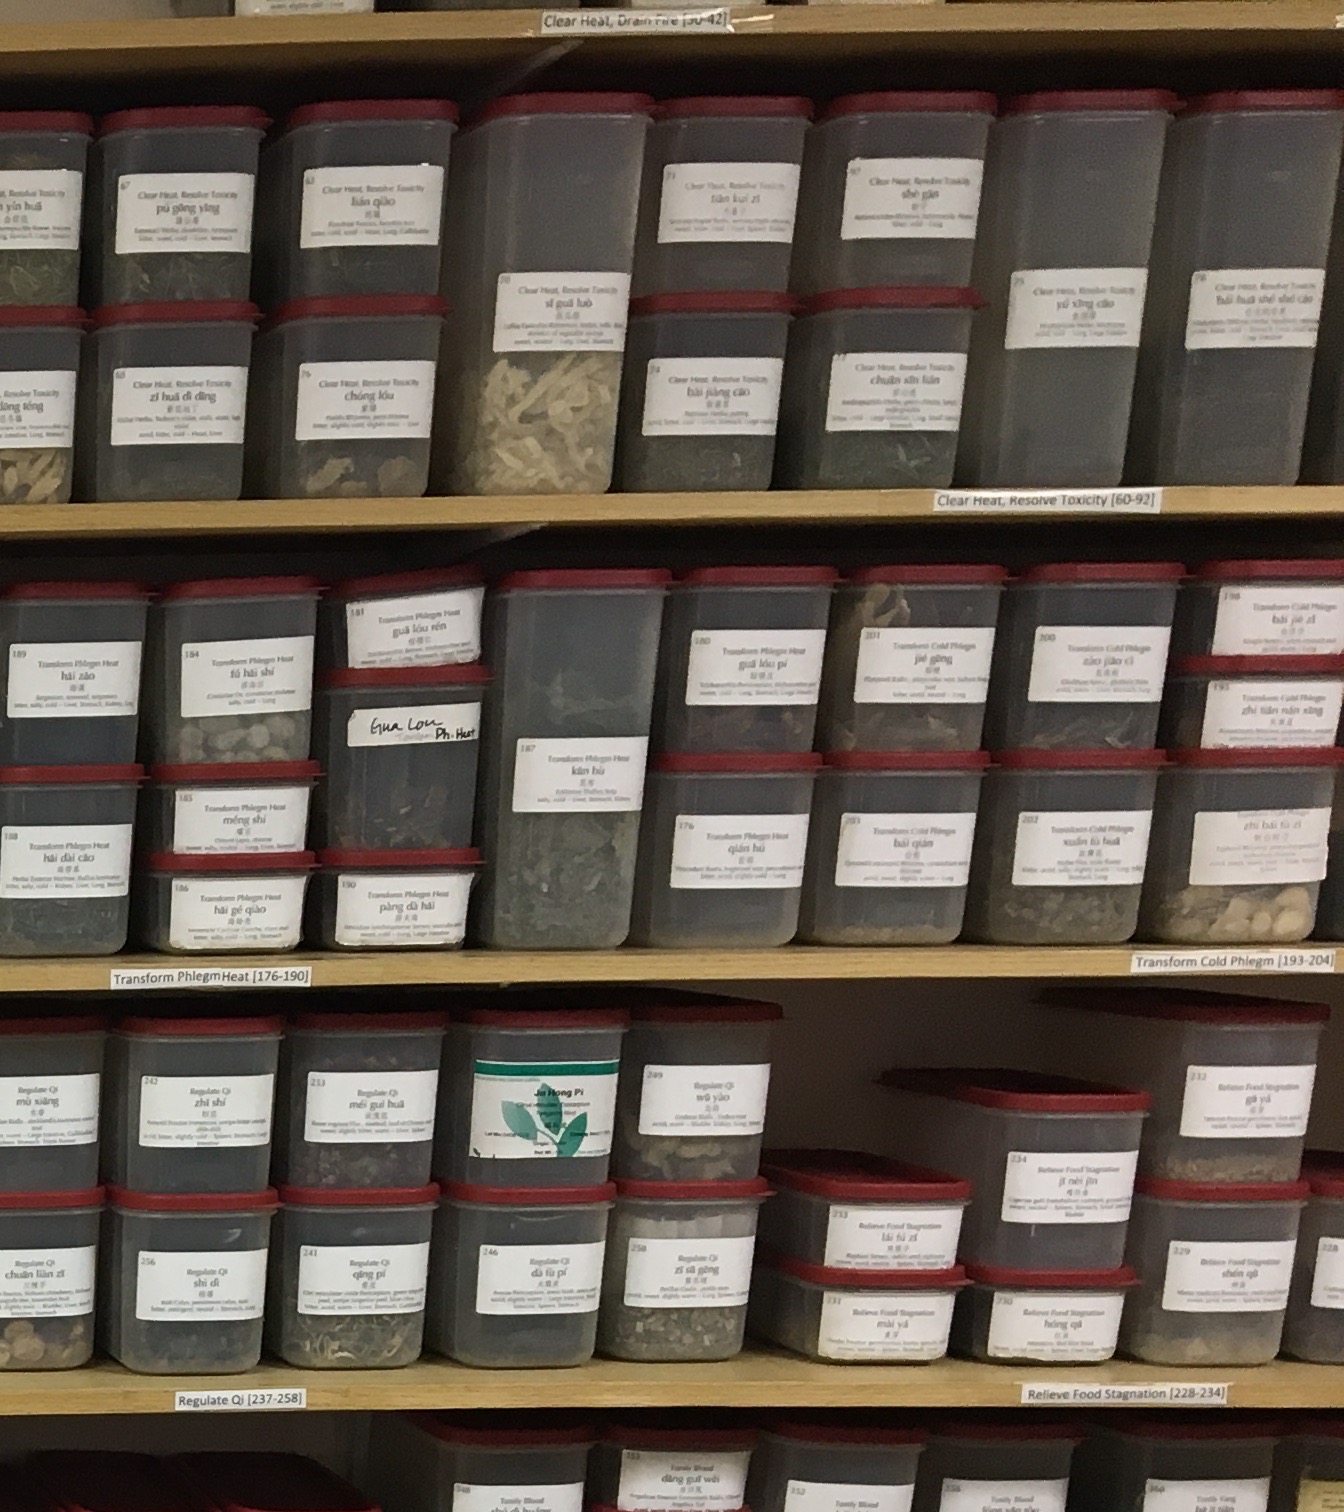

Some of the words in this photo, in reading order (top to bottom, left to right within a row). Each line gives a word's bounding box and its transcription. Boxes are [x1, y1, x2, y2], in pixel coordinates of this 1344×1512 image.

[543, 15, 577, 27] Clear
[581, 15, 614, 28] Heat,
[937, 495, 970, 507] Clear
[973, 495, 1005, 507] Heat,
[1010, 495, 1057, 506] Resolve
[1061, 494, 1108, 507] Toxicity
[1111, 492, 1156, 507] [60-92]
[1136, 956, 1197, 969] Transform
[1201, 955, 1228, 967] Cold
[1230, 955, 1275, 970] Phlegm
[1278, 953, 1334, 968] [193-204]
[114, 972, 174, 985] Transform
[178, 971, 221, 986] Phlegm
[222, 971, 249, 982] Heat
[253, 967, 308, 983] [176-190]
[178, 1395, 228, 1408] Regulate
[231, 1394, 244, 1406] Qi
[248, 1392, 302, 1406] [237-258]
[1028, 1390, 1069, 1401] Relieve
[1073, 1389, 1102, 1401] Food
[1105, 1388, 1166, 1402] Stagnation
[1170, 1386, 1225, 1401] [228-234]
